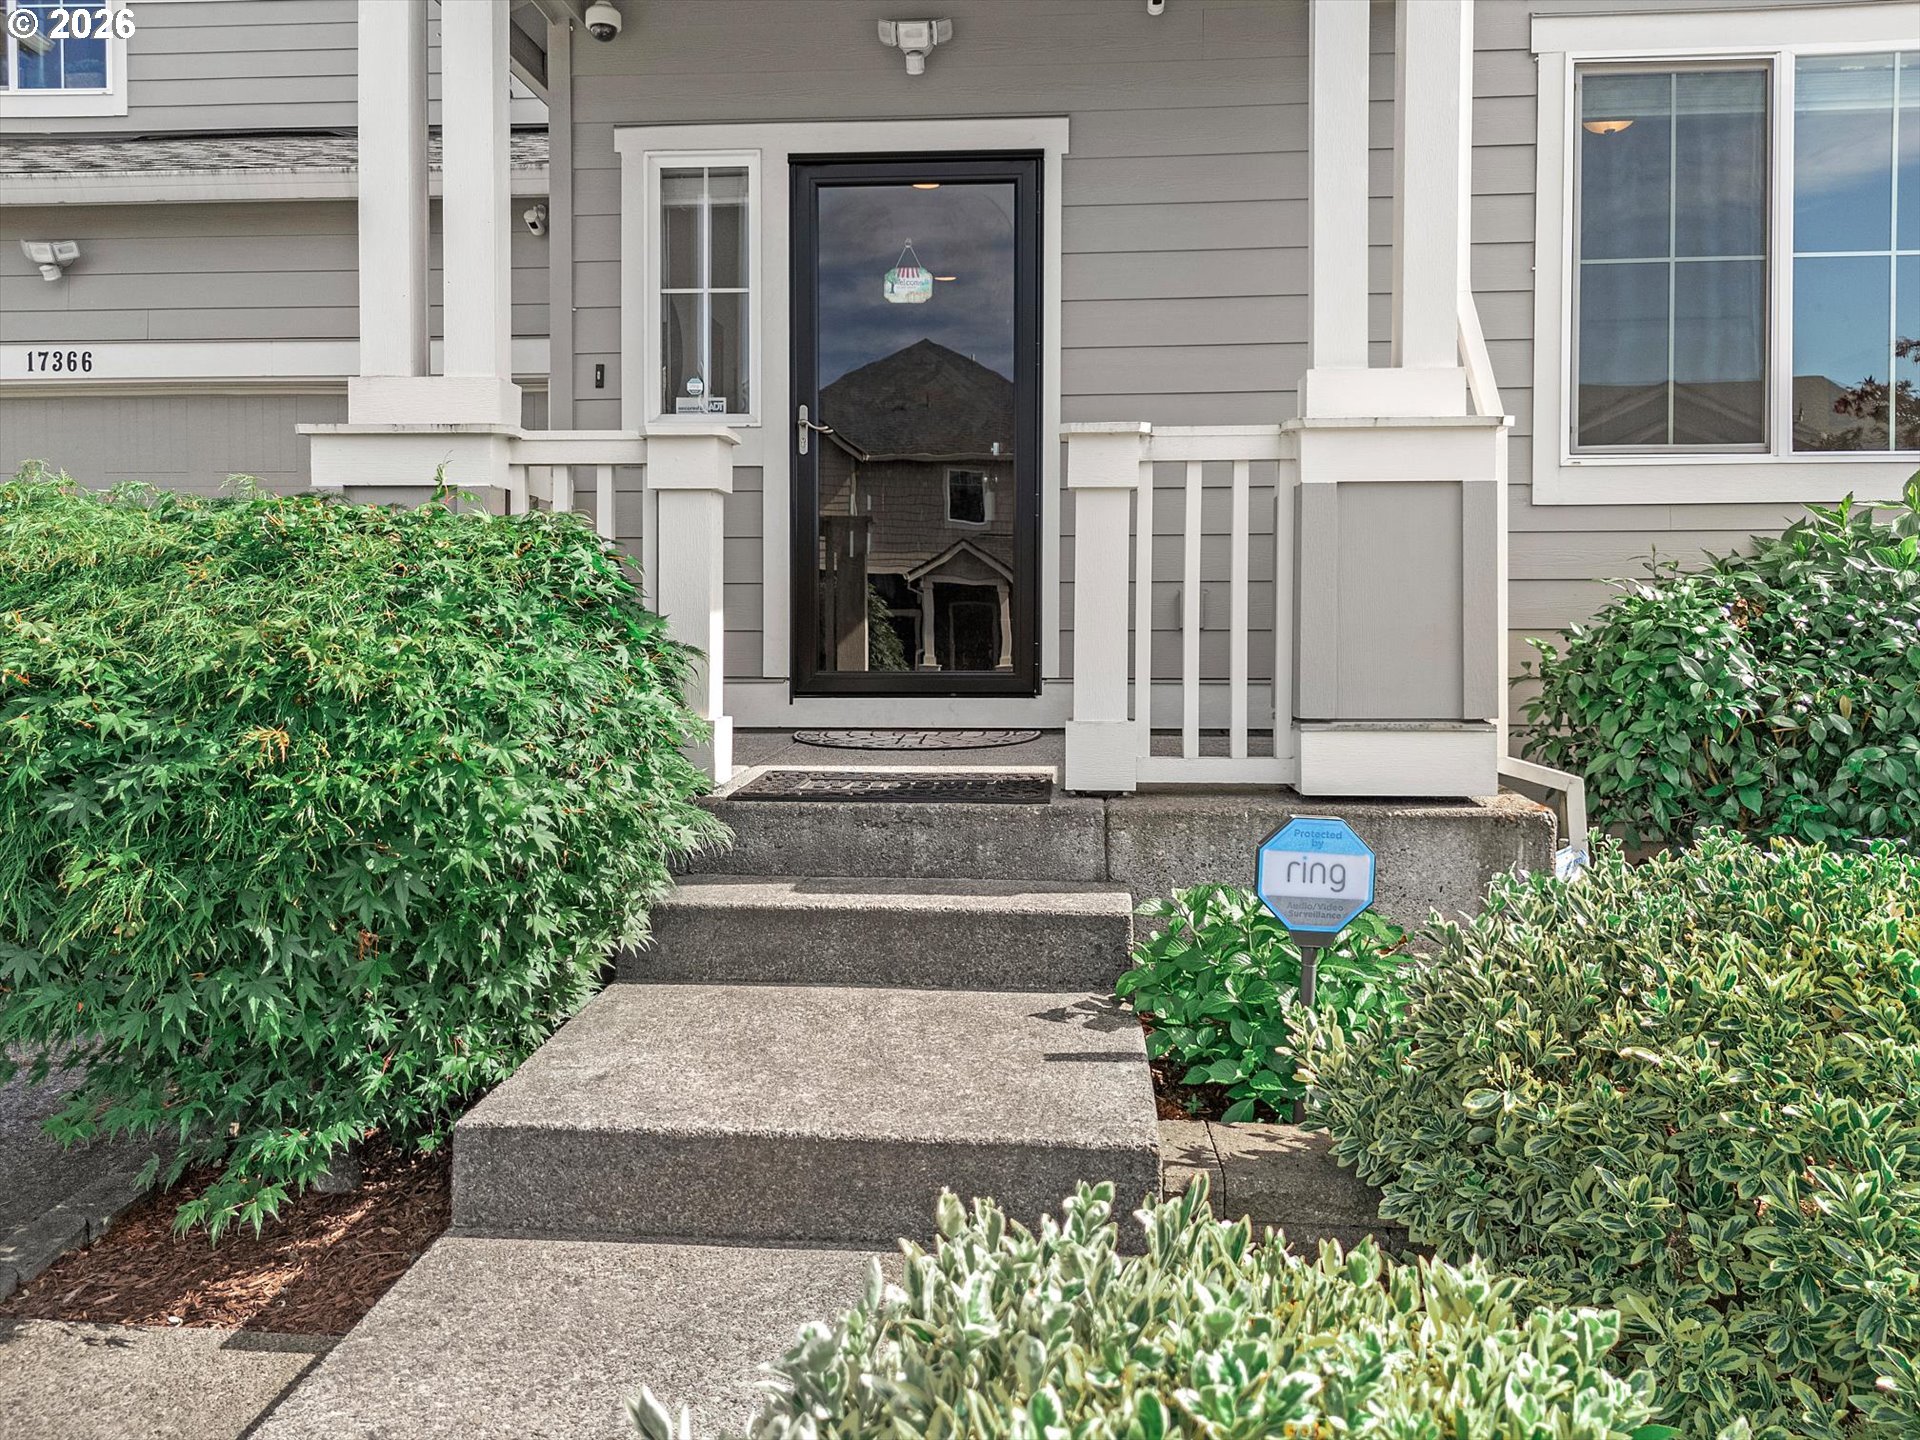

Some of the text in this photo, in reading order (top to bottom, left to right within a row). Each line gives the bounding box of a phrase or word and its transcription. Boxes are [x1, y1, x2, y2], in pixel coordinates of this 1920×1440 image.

[27, 350, 93, 372] 17366
[708, 402, 724, 411] ADT
[1293, 828, 1343, 840] Protected
[1311, 839, 1324, 849] by
[1286, 856, 1347, 893] ring
[1286, 901, 1344, 912] Audio/Video
[1287, 910, 1342, 919] Surveillance
